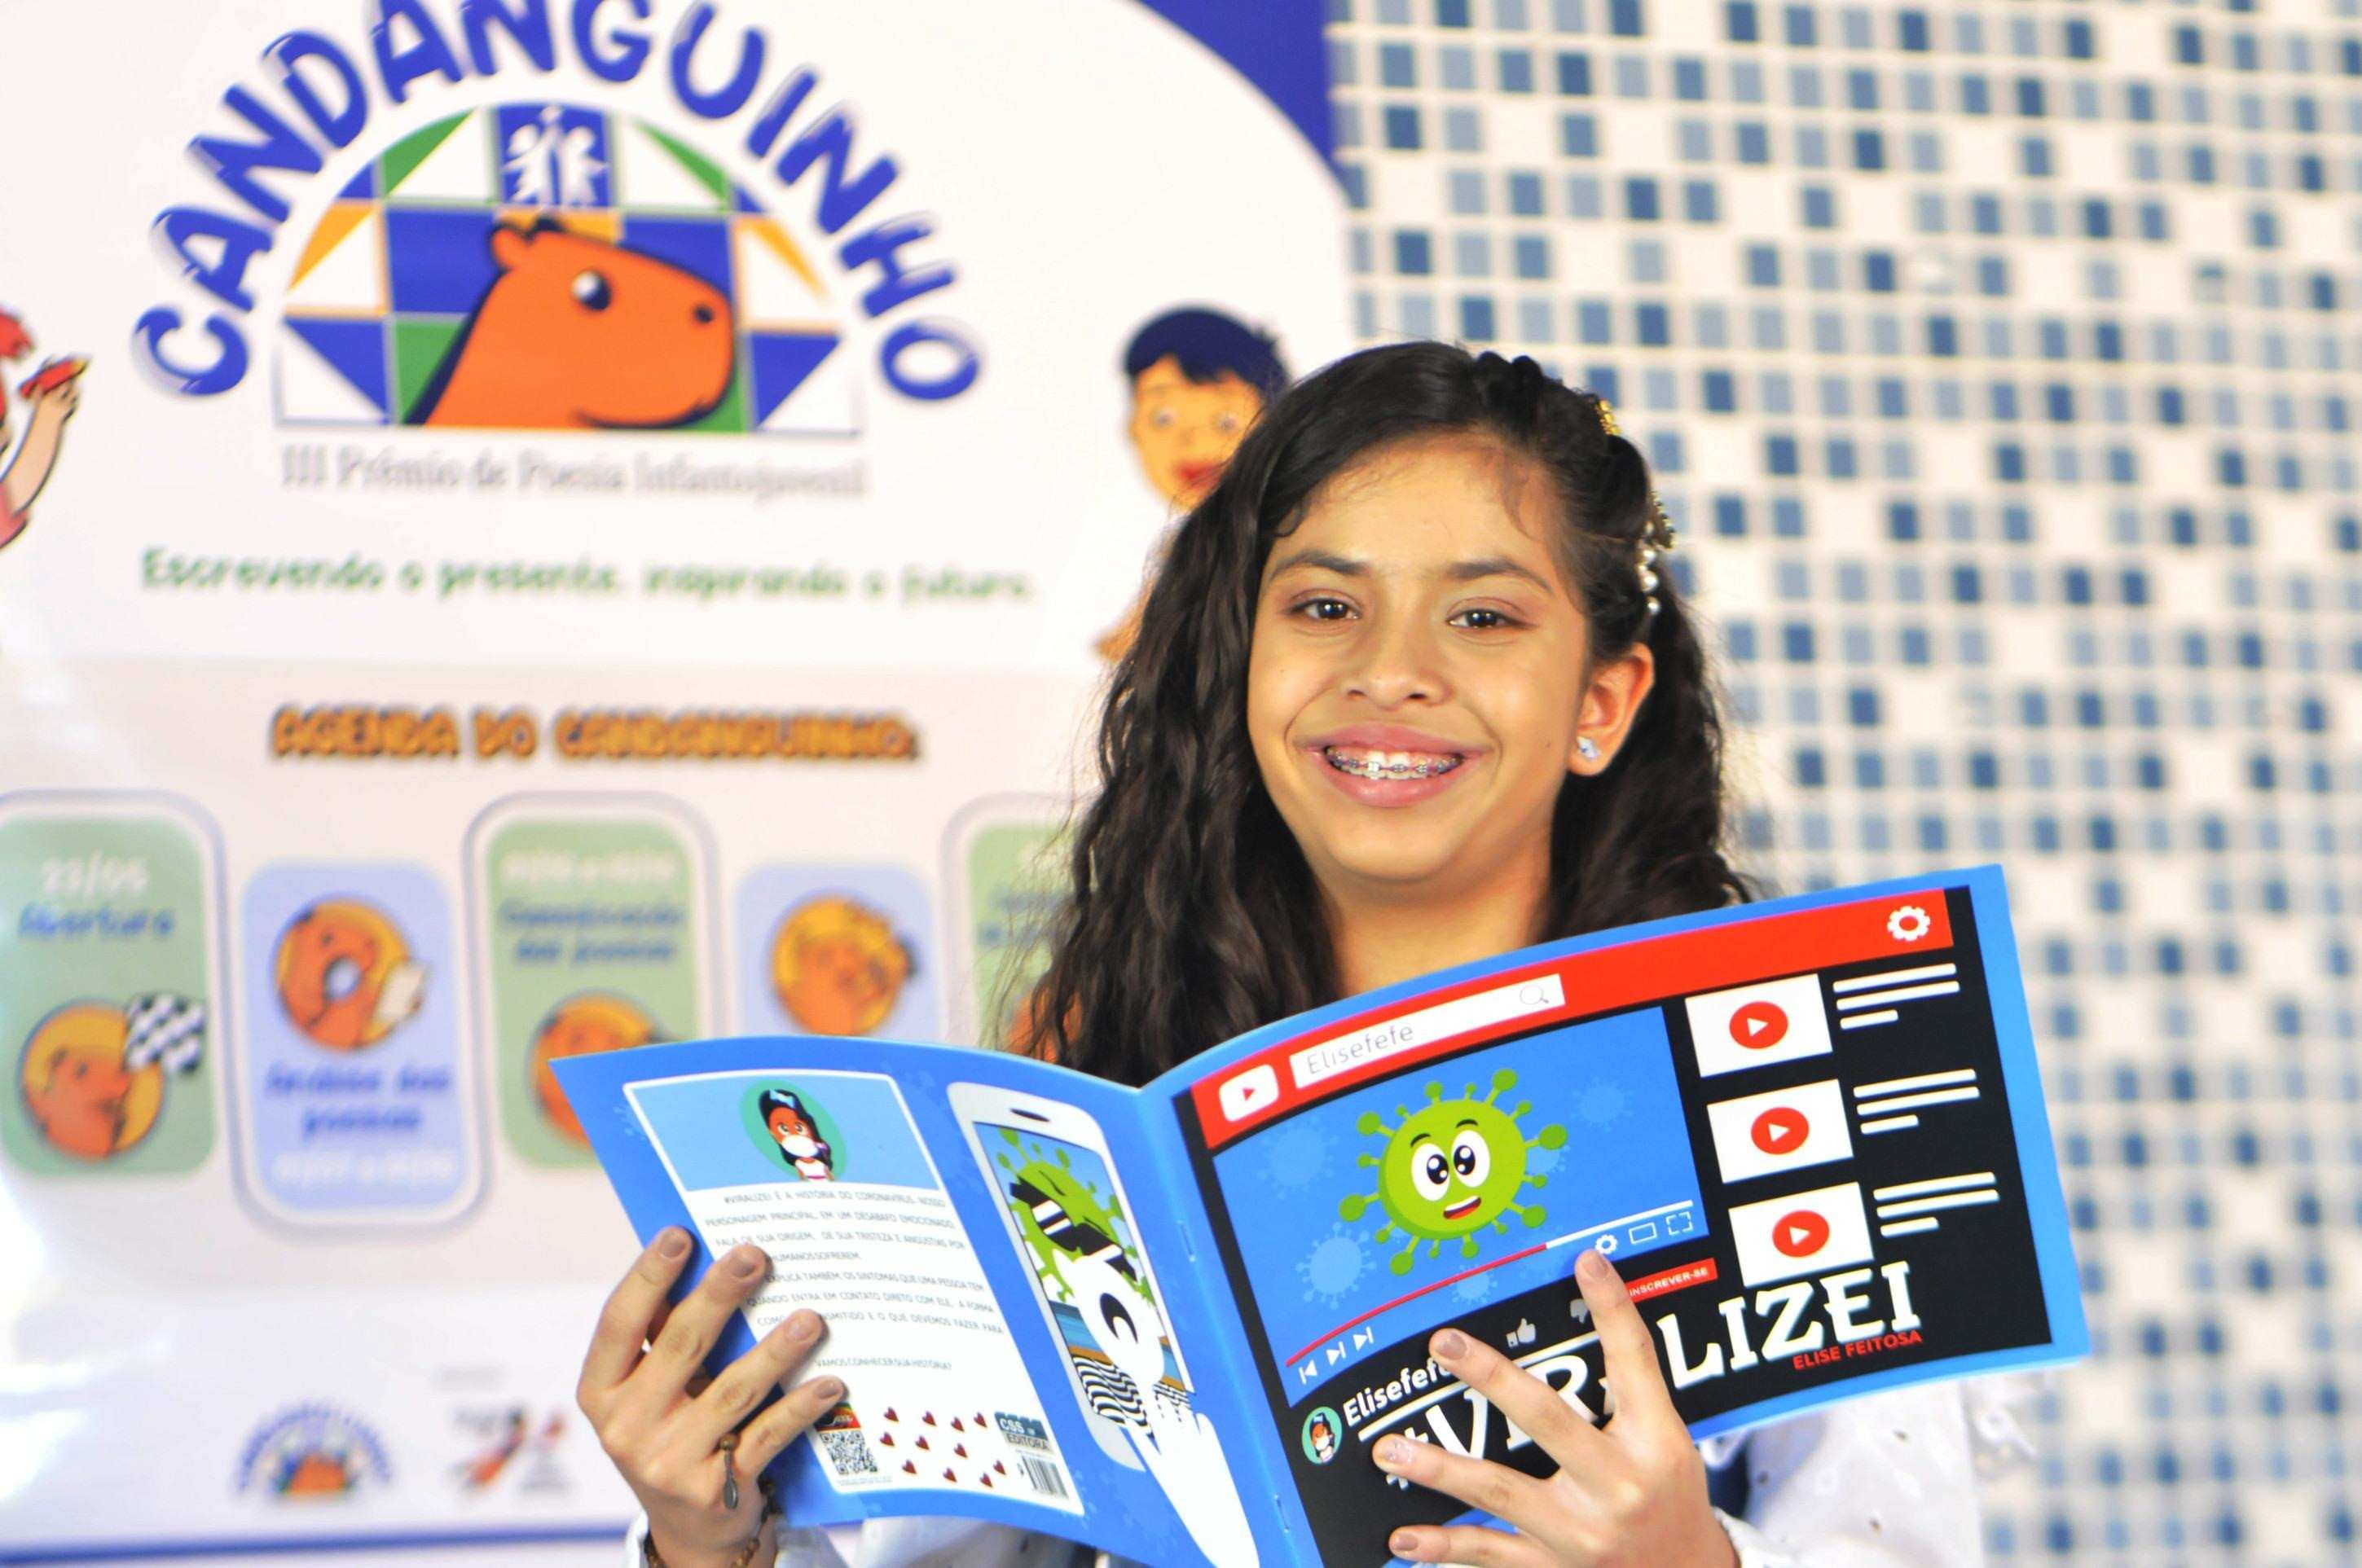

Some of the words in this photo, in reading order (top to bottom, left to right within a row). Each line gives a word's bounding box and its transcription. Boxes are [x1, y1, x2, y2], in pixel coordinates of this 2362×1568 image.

[130, 0, 983, 402] CANDANGUINHO
[473, 705, 539, 759] DO
[1306, 1022, 1415, 1075] Elisefefe
[1629, 1267, 1709, 1298] INSCREVER-SE
[1792, 1344, 1843, 1370] ELISE
[1845, 1329, 1923, 1358] FEITOSA
[999, 1417, 1025, 1434] CSS
[1005, 1433, 1052, 1451] EDITORA
